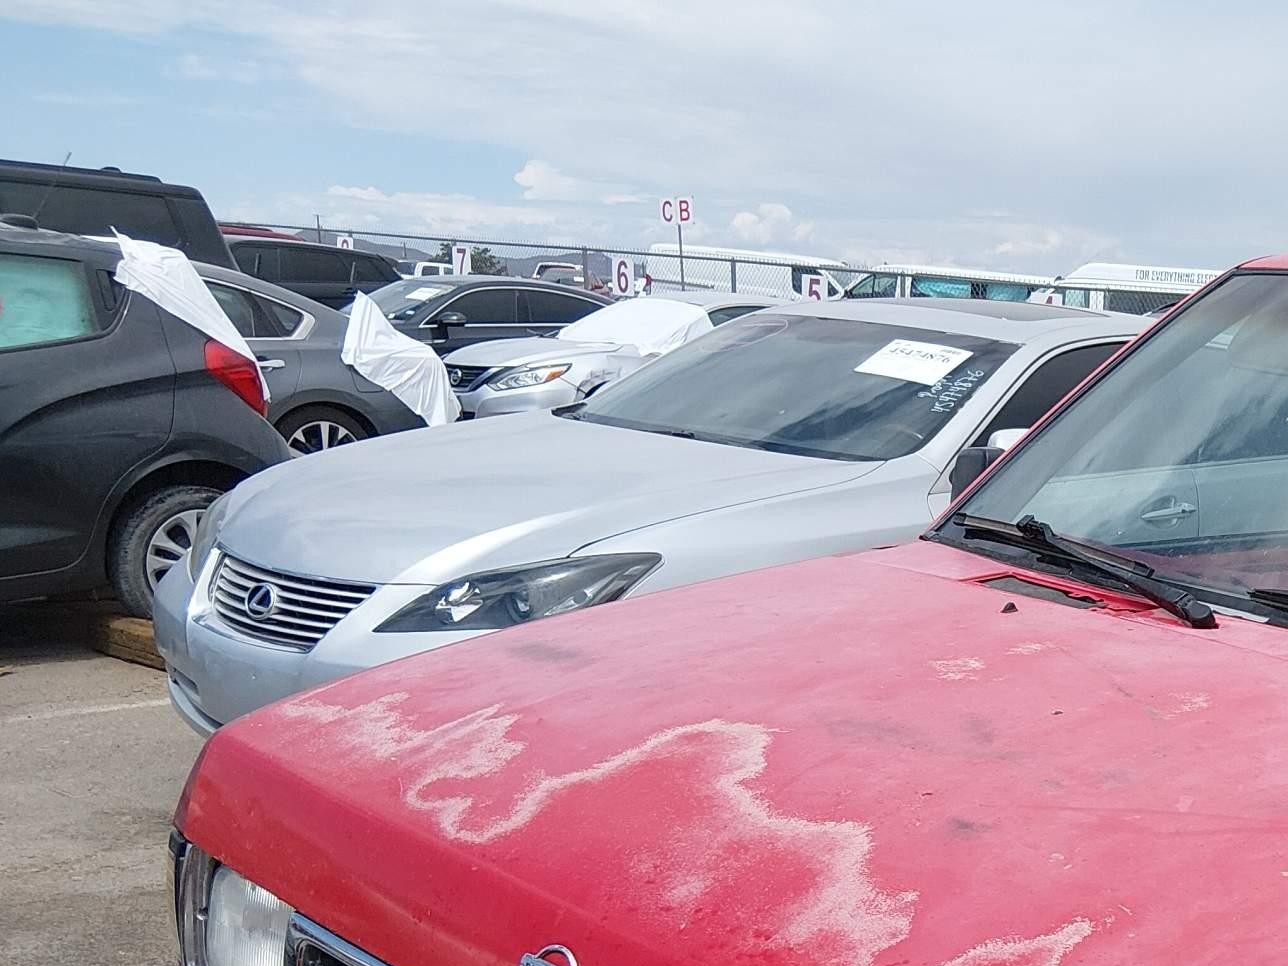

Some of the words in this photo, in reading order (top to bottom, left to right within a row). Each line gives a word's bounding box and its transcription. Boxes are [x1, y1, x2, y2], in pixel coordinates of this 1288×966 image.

[662, 200, 673, 222] C
[679, 200, 690, 221] B
[456, 248, 467, 275] 7
[617, 260, 629, 293] 6
[1135, 270, 1150, 281] FOR
[1151, 271, 1195, 284] EVERYTHING
[808, 278, 821, 301] 5
